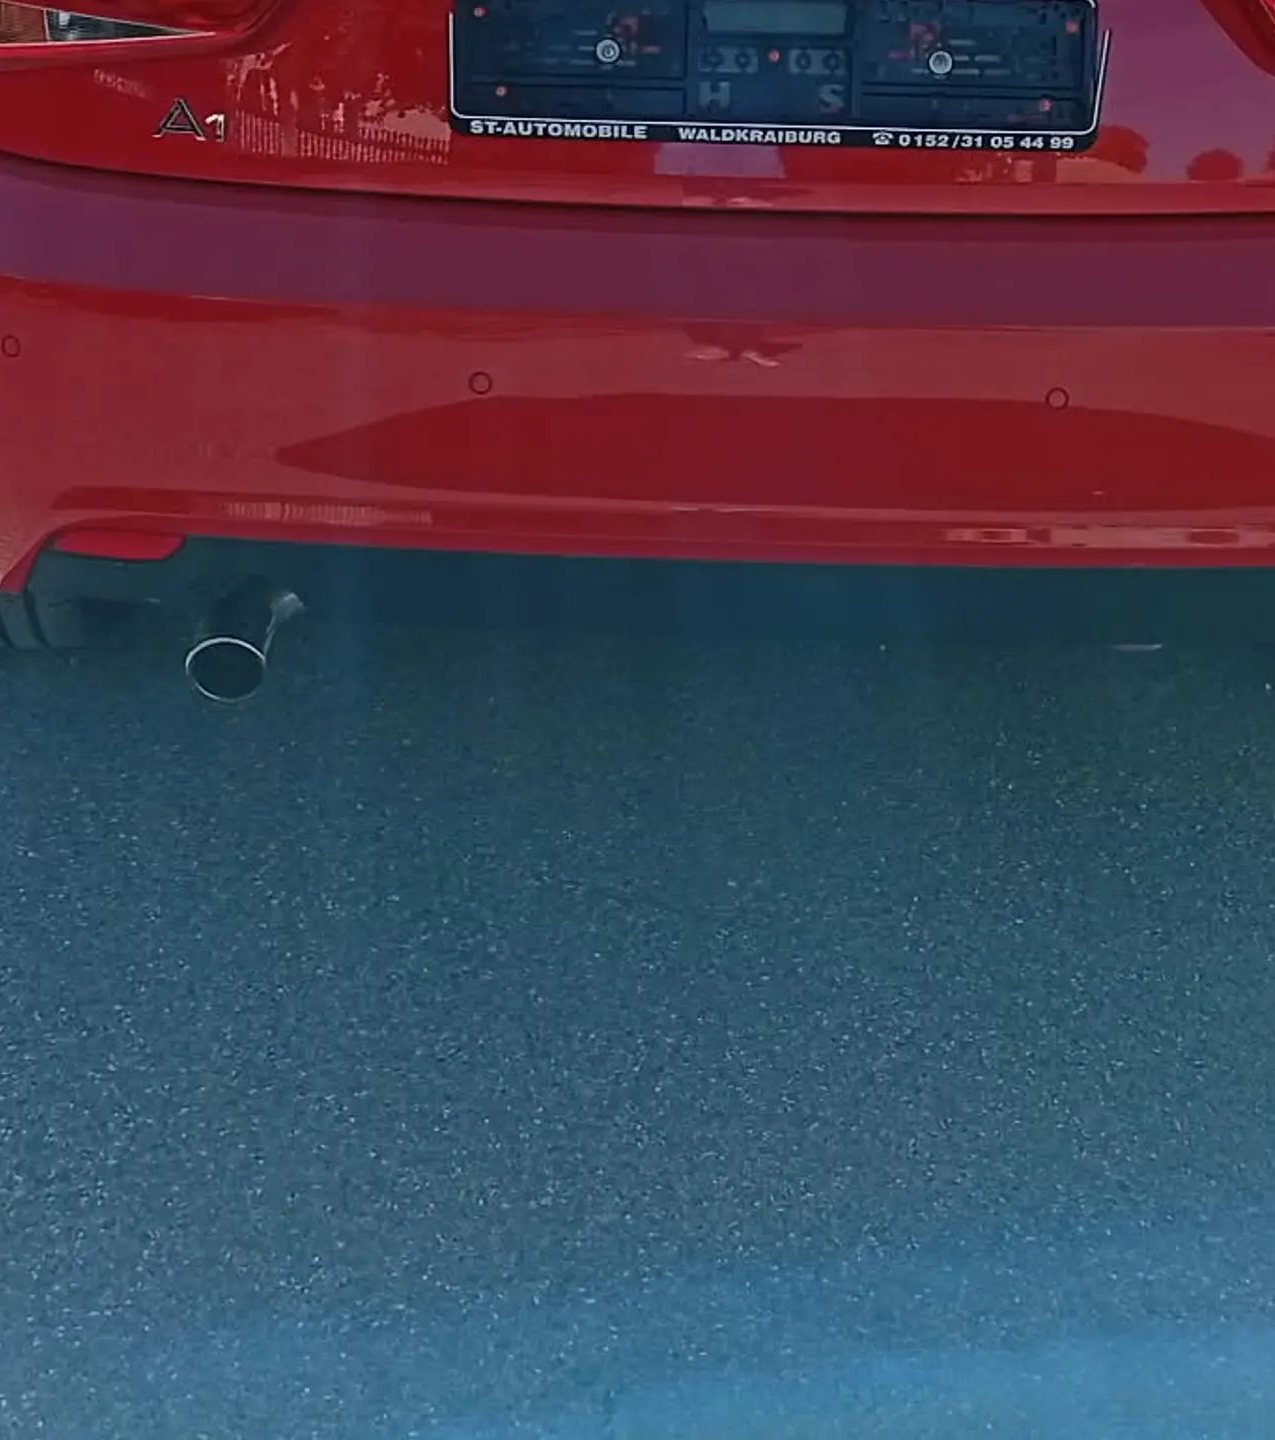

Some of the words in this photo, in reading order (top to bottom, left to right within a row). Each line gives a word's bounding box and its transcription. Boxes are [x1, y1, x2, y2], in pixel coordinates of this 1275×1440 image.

[152, 97, 225, 142] A1
[469, 120, 648, 140] ST-AUTOMOBILE
[678, 127, 842, 145] WALDKRAIBURG
[989, 136, 1015, 149] 05
[1019, 136, 1045, 150] 44
[1049, 137, 1074, 150] 99
